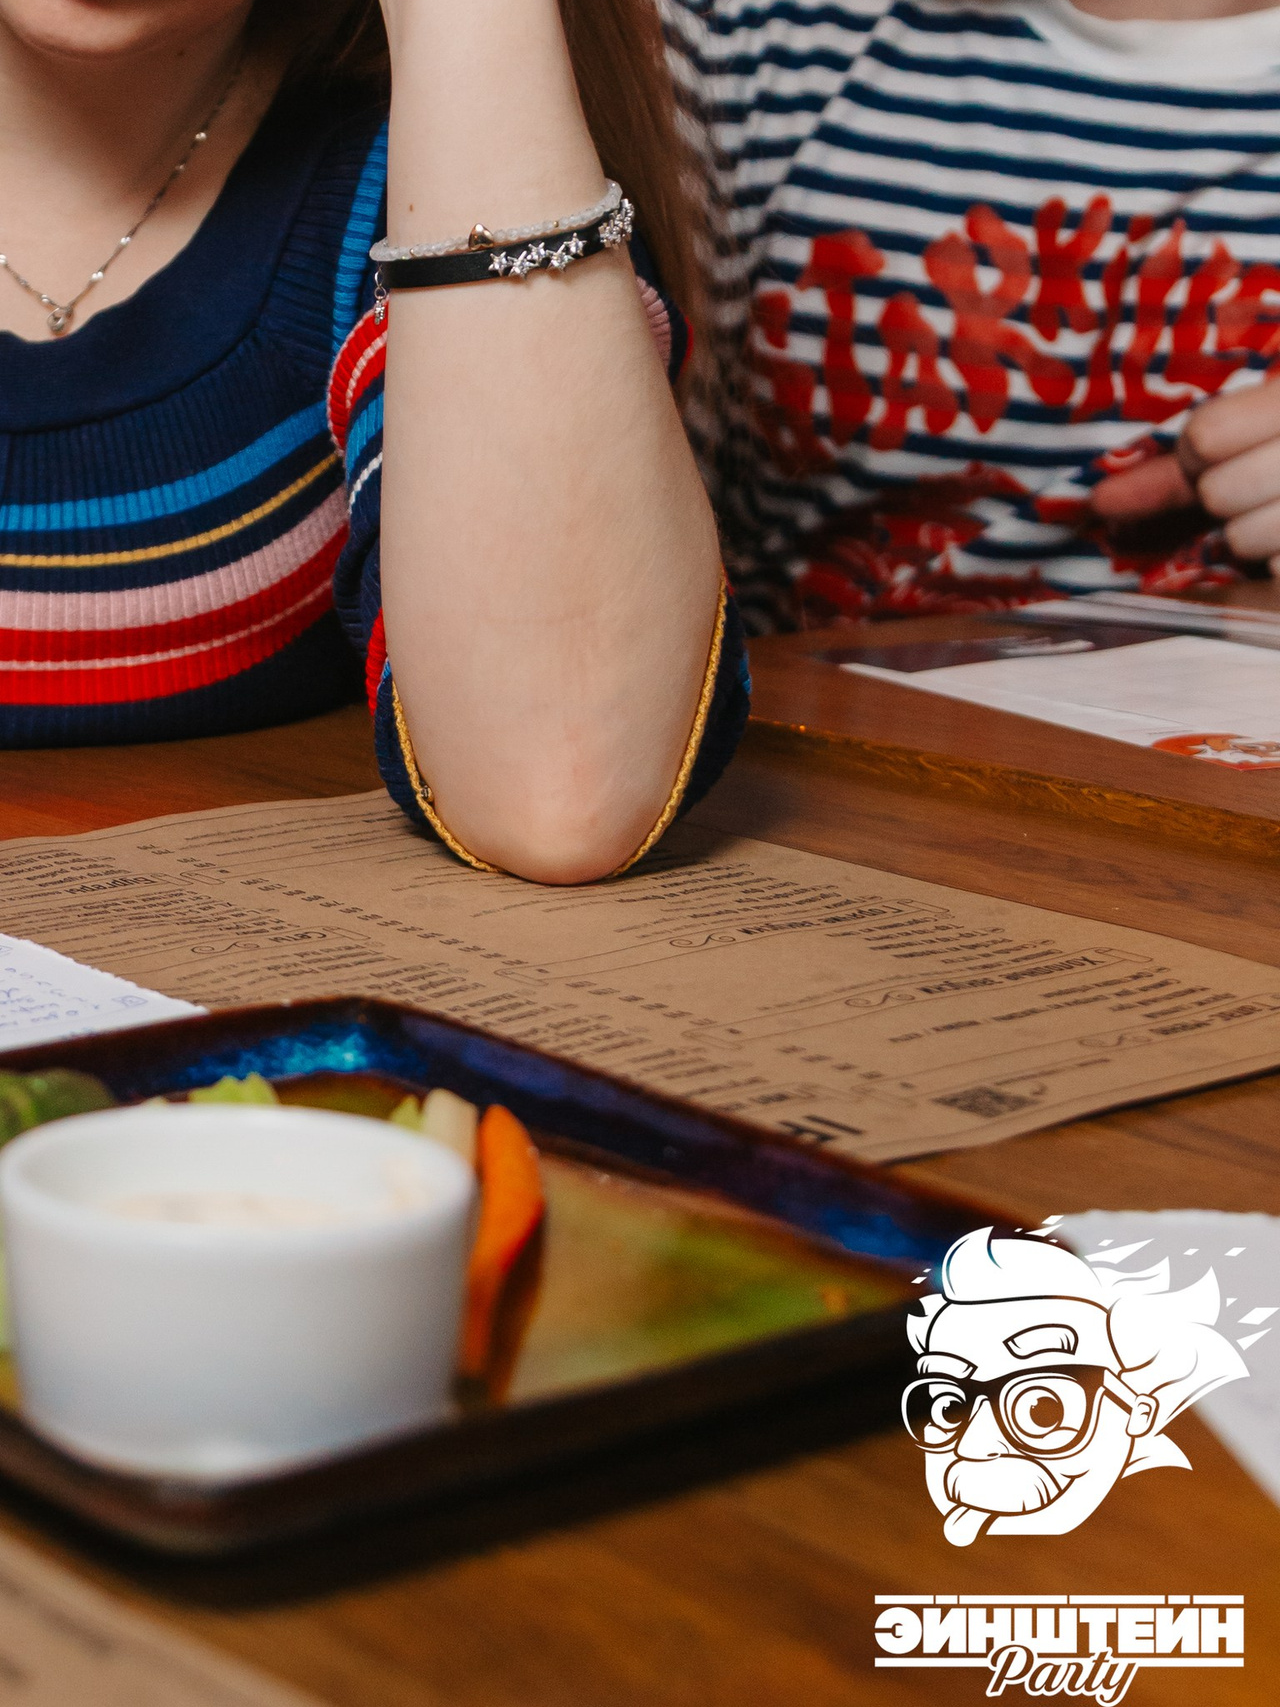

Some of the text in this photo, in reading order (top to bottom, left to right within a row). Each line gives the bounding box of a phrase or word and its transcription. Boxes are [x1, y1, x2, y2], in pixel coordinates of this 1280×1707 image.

[64, 875, 156, 895] Бургеры
[819, 904, 904, 924] Горячие
[267, 928, 328, 945] Сеты
[736, 921, 818, 936] закуски
[916, 955, 1104, 995] Холодные закуски
